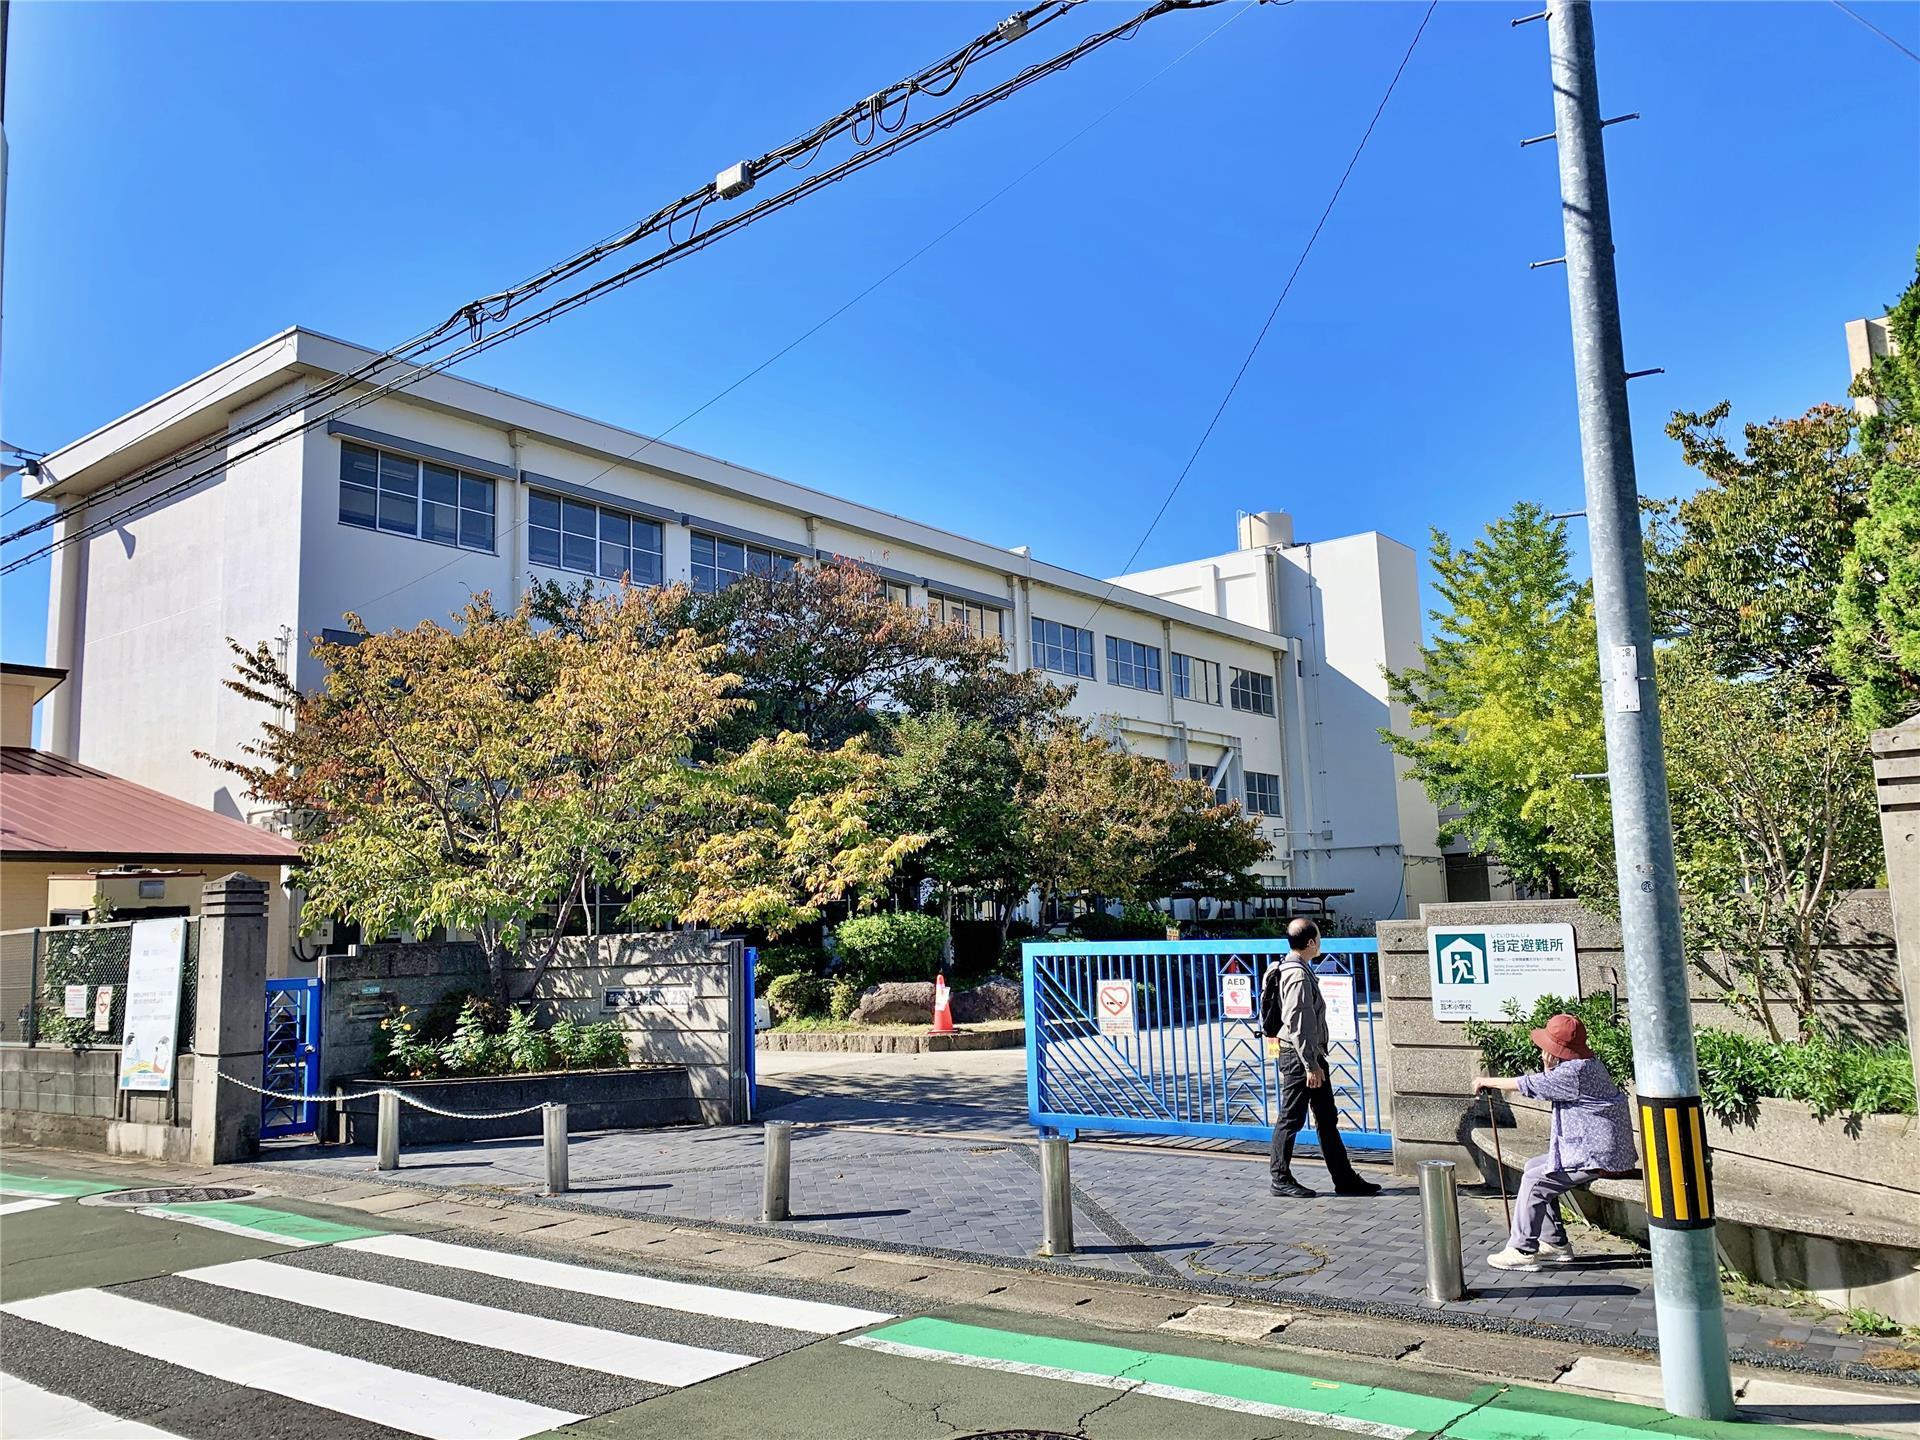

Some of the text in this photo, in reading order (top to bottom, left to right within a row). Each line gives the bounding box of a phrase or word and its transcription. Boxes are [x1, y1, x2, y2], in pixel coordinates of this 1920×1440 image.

[1492, 938, 1564, 952] 指定避難所
[1227, 978, 1246, 986] AED
